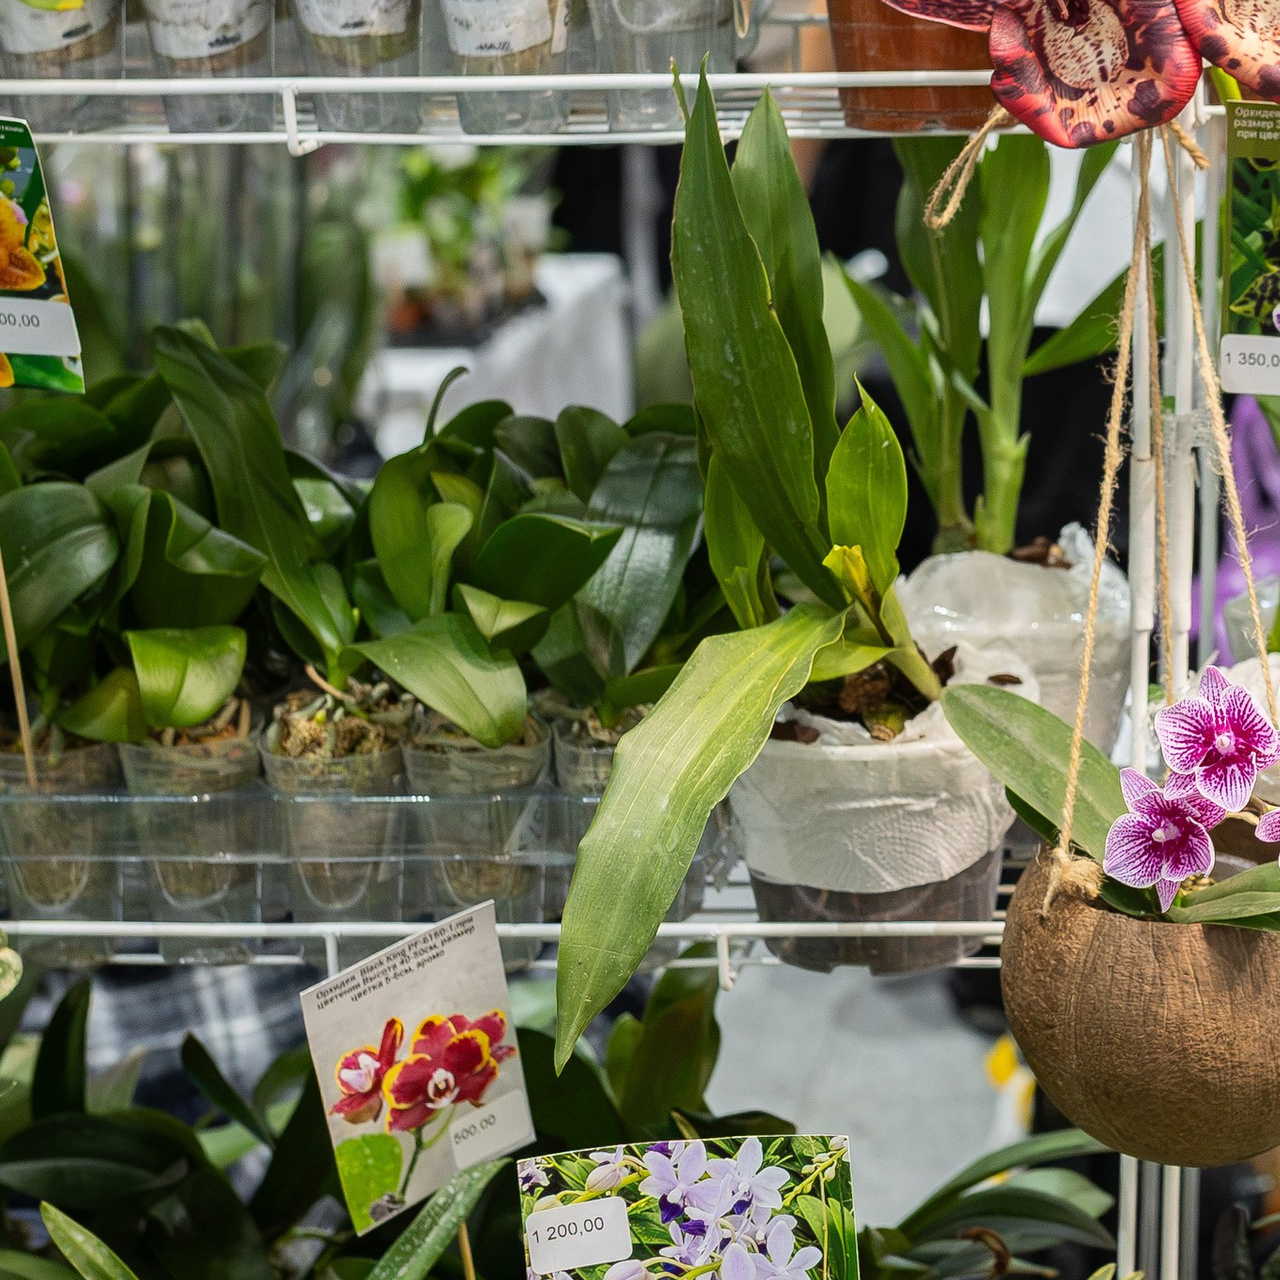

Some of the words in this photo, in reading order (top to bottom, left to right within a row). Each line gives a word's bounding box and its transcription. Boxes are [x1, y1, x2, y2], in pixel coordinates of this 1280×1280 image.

[1234, 119, 1274, 130] размер
[1235, 107, 1280, 119] Орхидея
[1237, 130, 1257, 140] при
[1225, 352, 1231, 364] 1
[317, 982, 361, 1010] цветении
[362, 964, 398, 986] Высота
[440, 925, 475, 948] размер
[316, 975, 356, 1000] Орхидея
[360, 959, 385, 976] Black
[351, 980, 384, 1003] цветка
[453, 1113, 497, 1145] 500,00
[532, 1229, 540, 1244] 1
[546, 1216, 605, 1242] 200,00
